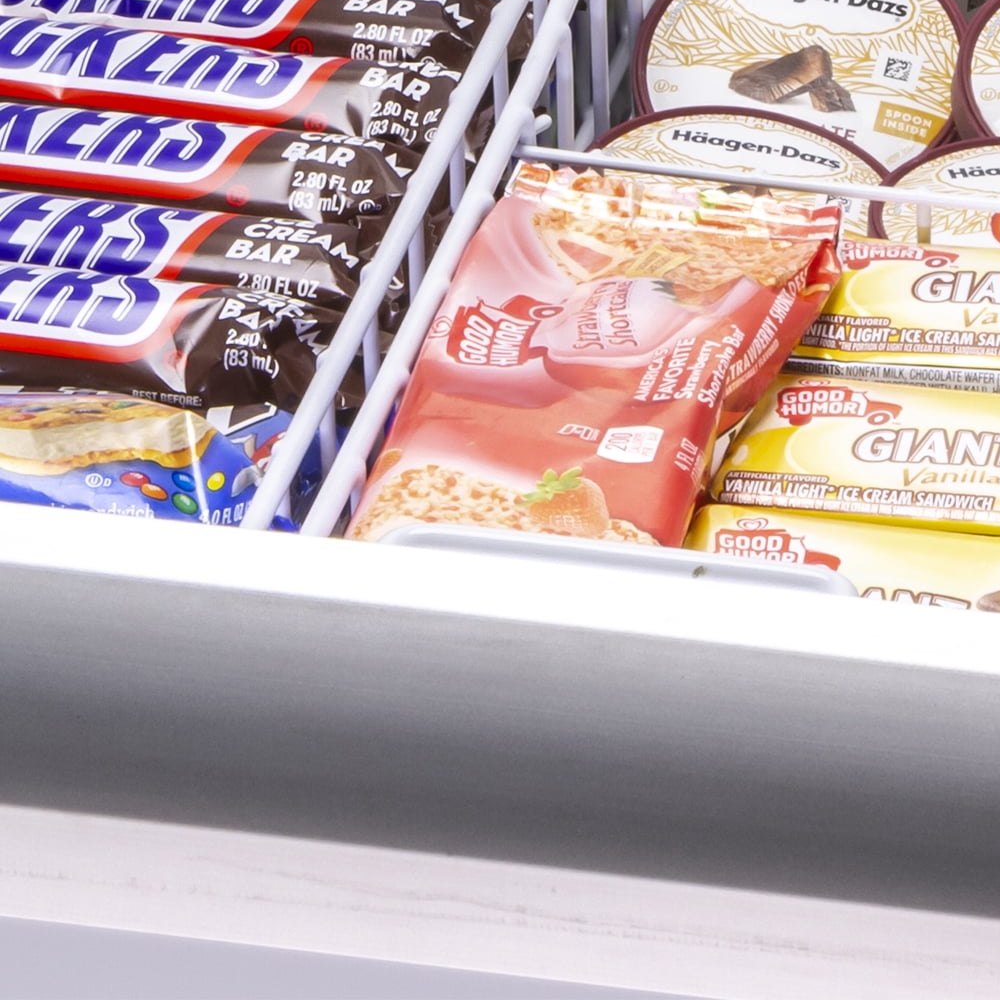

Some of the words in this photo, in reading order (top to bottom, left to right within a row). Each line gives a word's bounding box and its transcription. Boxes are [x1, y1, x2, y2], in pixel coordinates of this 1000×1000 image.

[352, 23, 387, 41] 2.80
[389, 26, 408, 44] FL
[411, 29, 434, 47] OZ
[359, 67, 431, 103] BAR
[370, 101, 401, 119] 2.80
[402, 108, 420, 128] FL
[422, 108, 443, 126] OZ
[881, 117, 930, 138] INSIDE
[884, 108, 933, 128] SPOON
[366, 120, 389, 139] (83
[389, 126, 419, 146] mL)
[281, 142, 357, 168] BAR
[671, 129, 842, 171] Häagen-Dazs
[291, 171, 328, 190] 2.80
[328, 174, 348, 192] FL
[351, 179, 374, 195] OZ
[288, 191, 316, 212] (83
[318, 195, 347, 215] mL)
[225, 239, 300, 265] BAR
[243, 224, 360, 269] CREAM
[237, 272, 273, 290] 2.80
[274, 275, 293, 295] FL
[296, 279, 321, 299] OZ
[846, 316, 891, 327] FLAVORED
[458, 314, 495, 365] GOOD
[488, 320, 530, 366] HUMOR
[899, 329, 923, 344] ICE
[924, 331, 974, 347] CREAM
[223, 348, 248, 371] (83
[250, 355, 280, 379] mL)
[652, 336, 697, 402] FAVORITE
[673, 340, 721, 401] Strawberry
[697, 344, 736, 409] Shortcake
[845, 366, 881, 379] NONFAT
[882, 368, 905, 380] MILK,
[908, 369, 963, 383] CHOCOLATE
[964, 371, 995, 385] WAFER
[160, 391, 203, 407] BEFORE:
[781, 400, 858, 417] HUMOR
[782, 390, 842, 404] GOOD
[726, 472, 782, 481] ARTIFICIALLY
[783, 474, 829, 484] FLAVORED
[901, 467, 1000, 488] Vanilla
[724, 479, 782, 496] VANILLA
[837, 486, 861, 501] ICE
[862, 489, 913, 505] CREAM
[914, 492, 995, 511] SANDWICH
[718, 533, 785, 552] GOOD
